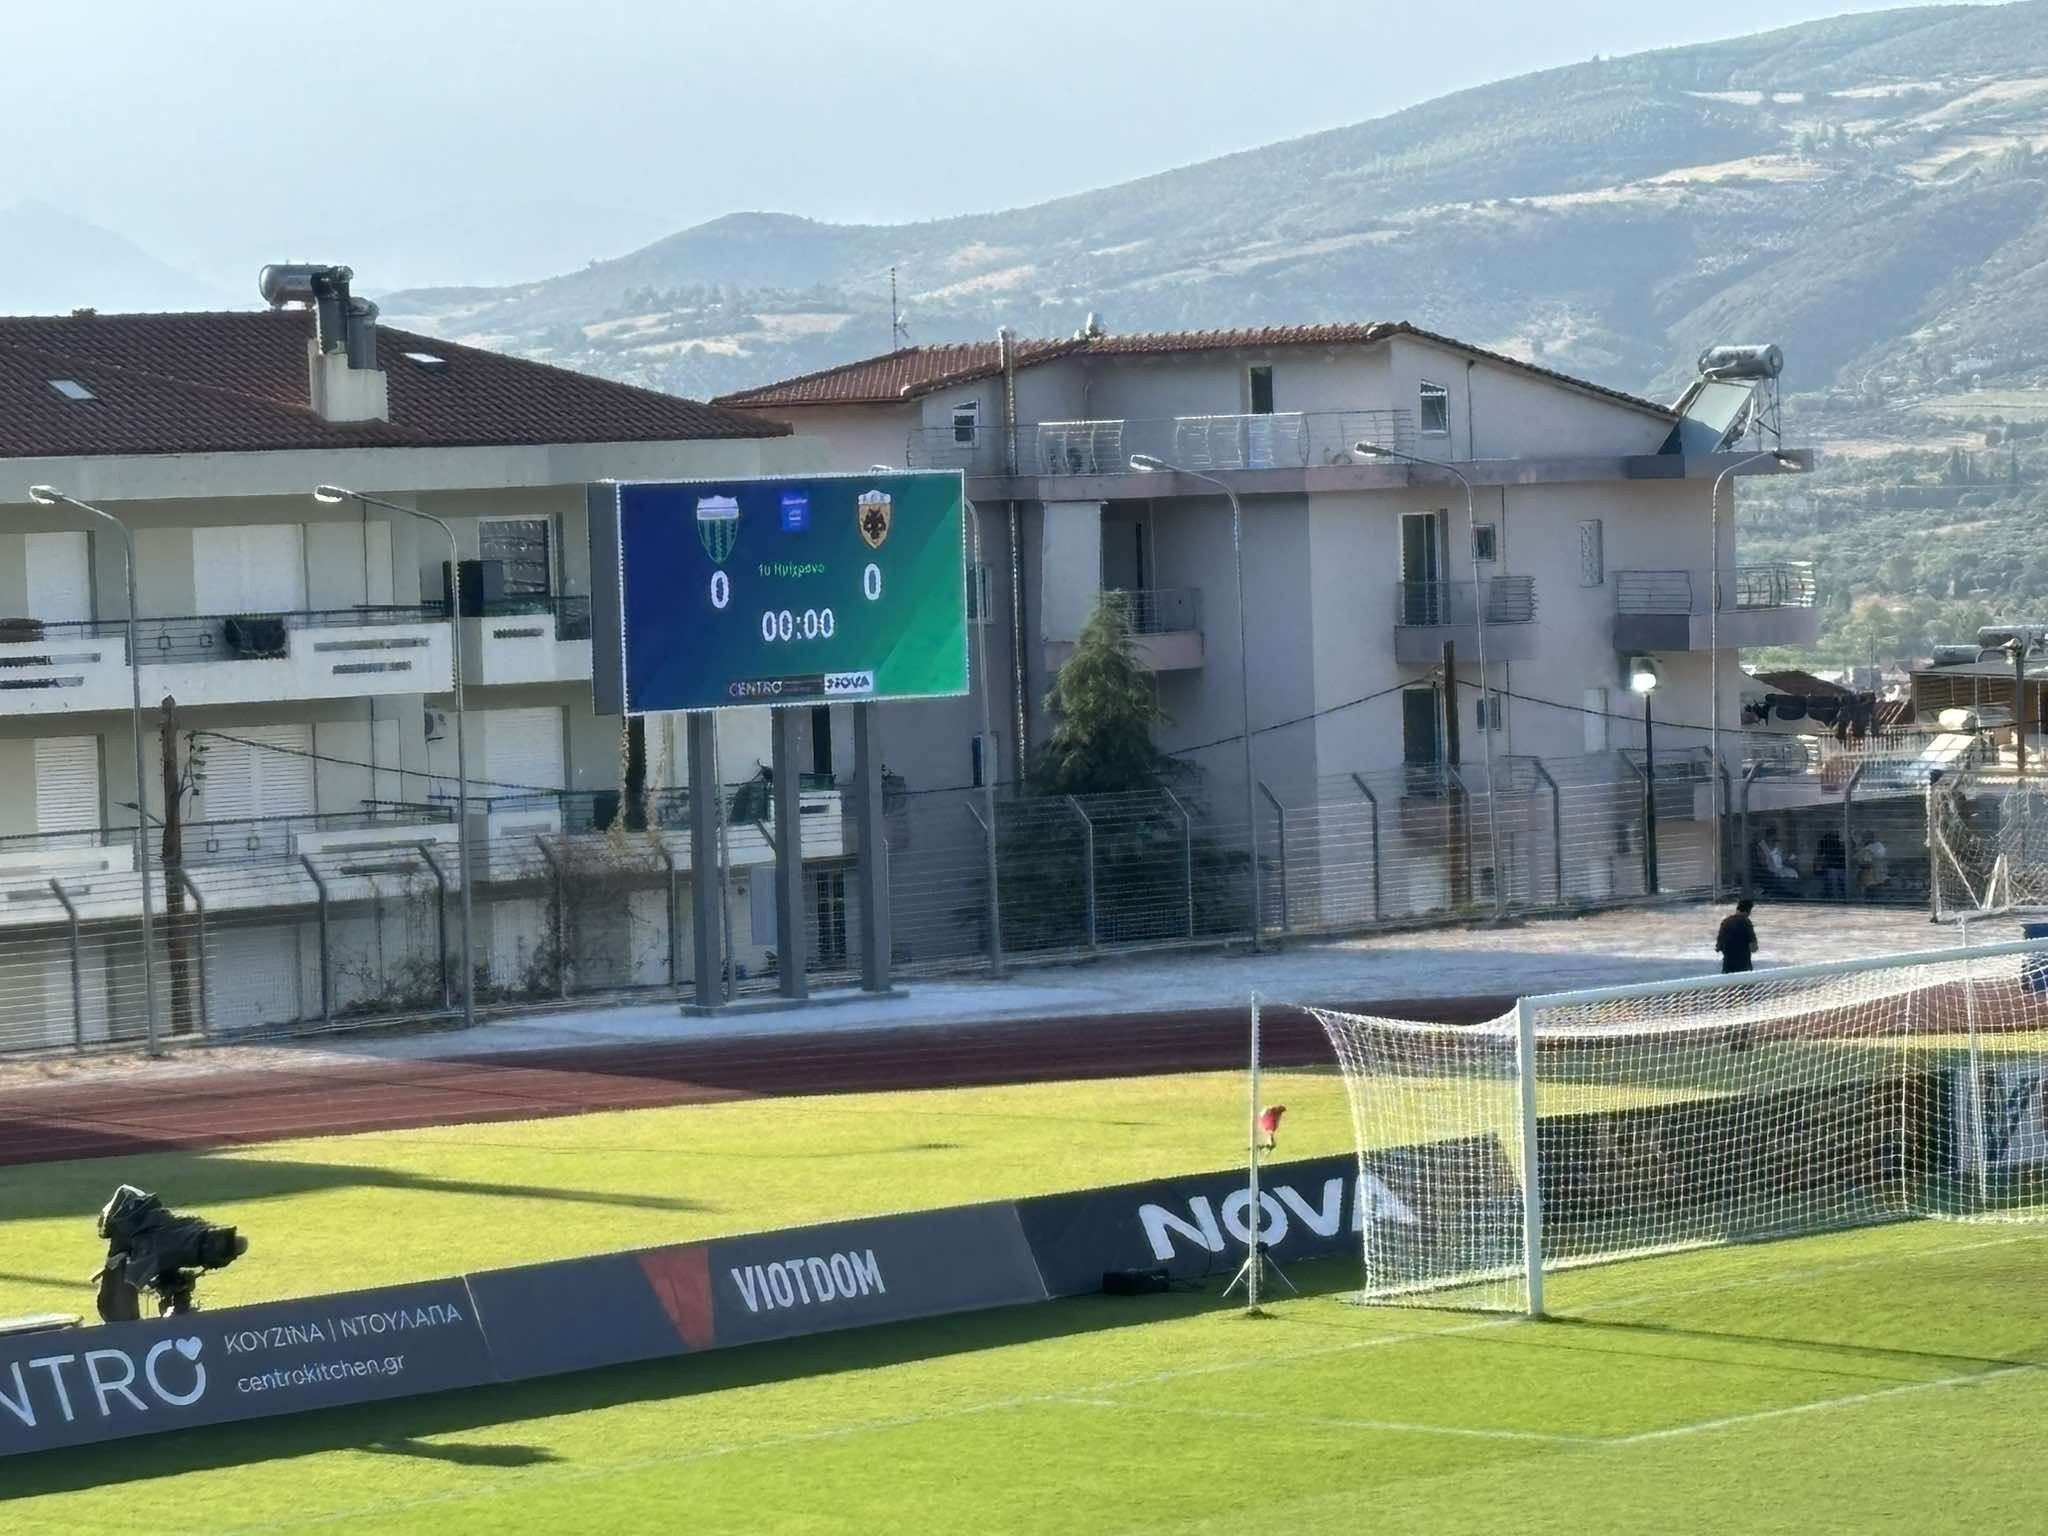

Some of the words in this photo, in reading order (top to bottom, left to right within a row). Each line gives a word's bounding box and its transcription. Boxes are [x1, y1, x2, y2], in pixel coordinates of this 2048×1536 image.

[710, 570, 730, 609] 0
[863, 562, 882, 601] 0
[762, 607, 835, 642] 00:00
[728, 680, 783, 697] CENTRO
[1138, 1171, 1418, 1260] NOVA
[730, 1249, 886, 1313] VIOTDOM
[223, 1318, 325, 1354] ΚΟΥΖΙΝΑ
[341, 1303, 463, 1338] ΝΤΟΥΛΑΠΑ
[238, 1353, 408, 1394] centrokitchen.gr
